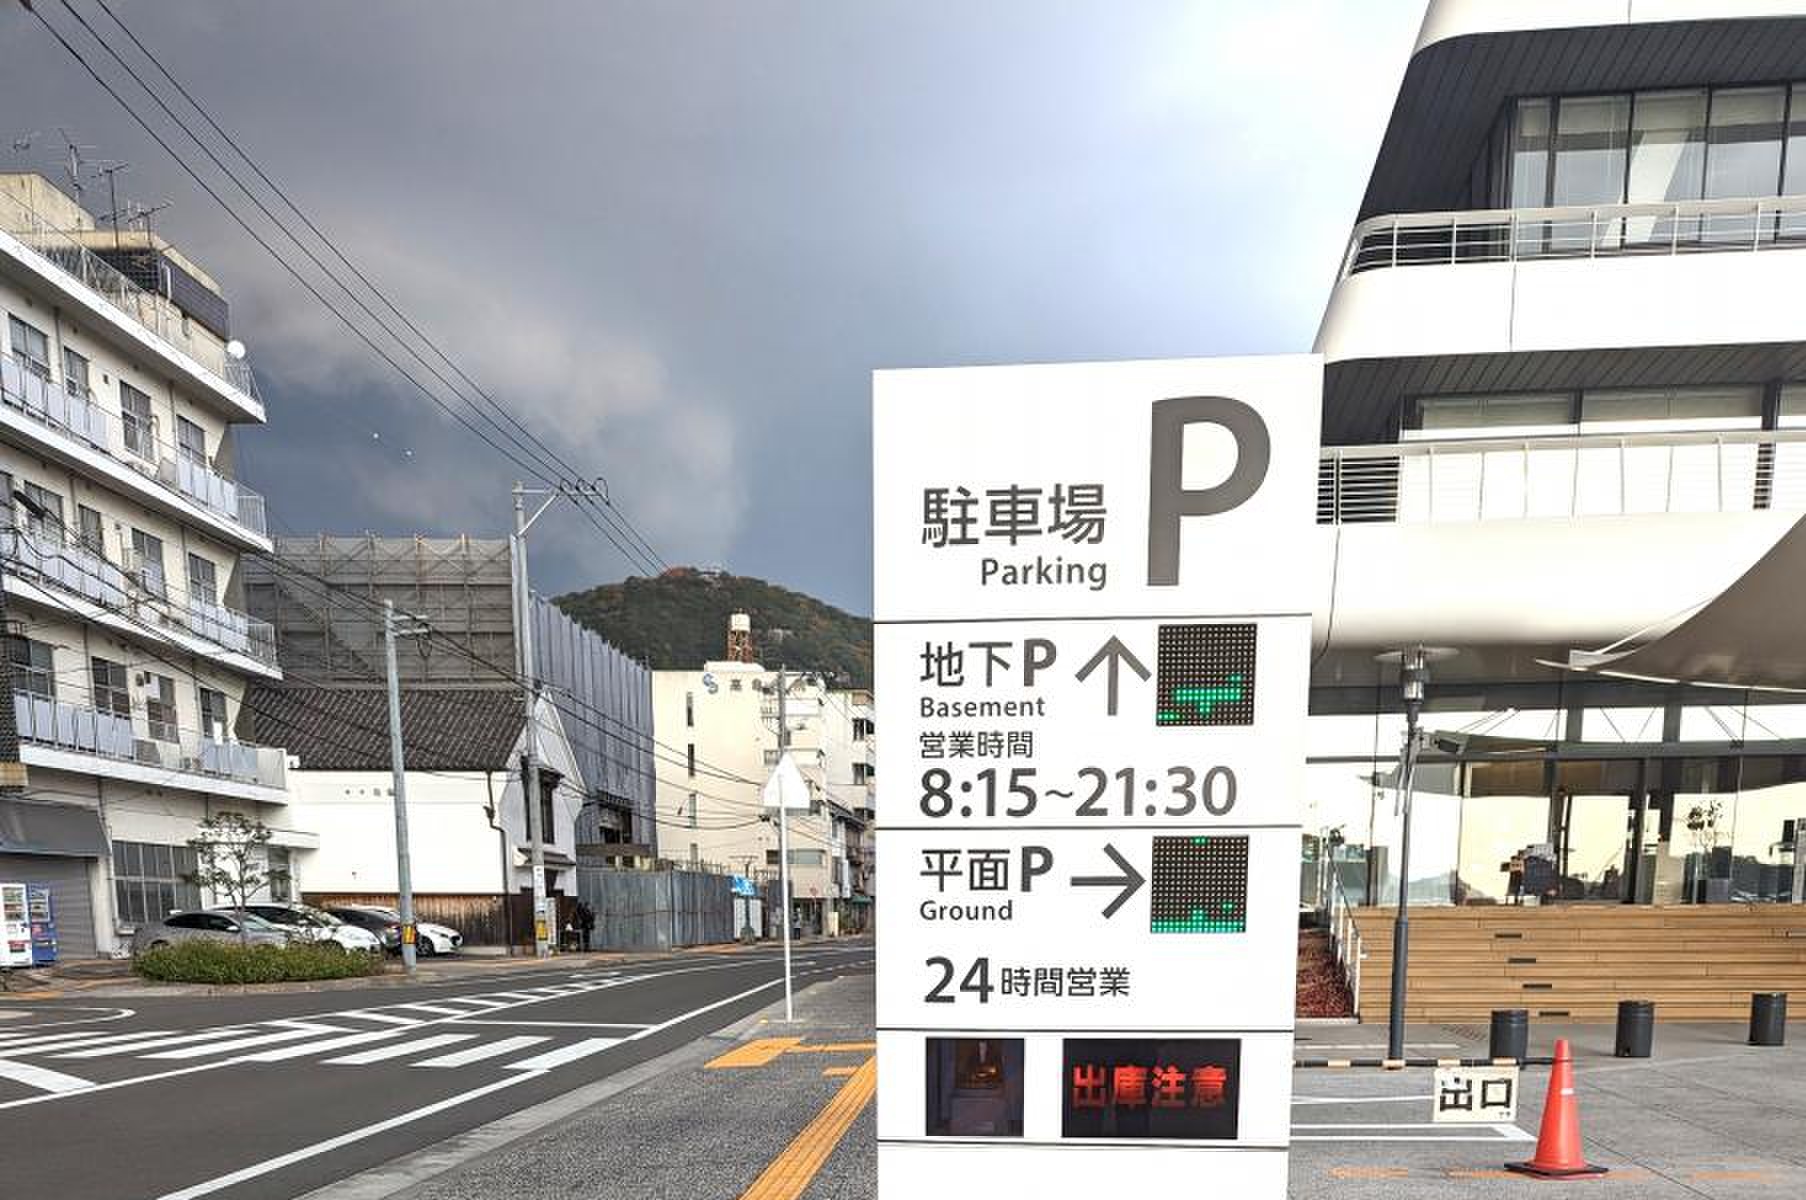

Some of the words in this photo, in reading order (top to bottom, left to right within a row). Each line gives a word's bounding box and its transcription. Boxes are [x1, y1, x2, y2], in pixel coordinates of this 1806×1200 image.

[1147, 396, 1270, 586] P
[922, 483, 1107, 548] 駐車場
[982, 556, 1106, 591] Parking
[921, 697, 1045, 718] Basement
[920, 731, 1033, 758] 営業時間
[920, 900, 1012, 920] Ground
[1072, 1064, 1228, 1109] 出庫注意
[1439, 1077, 1512, 1112] 出口
